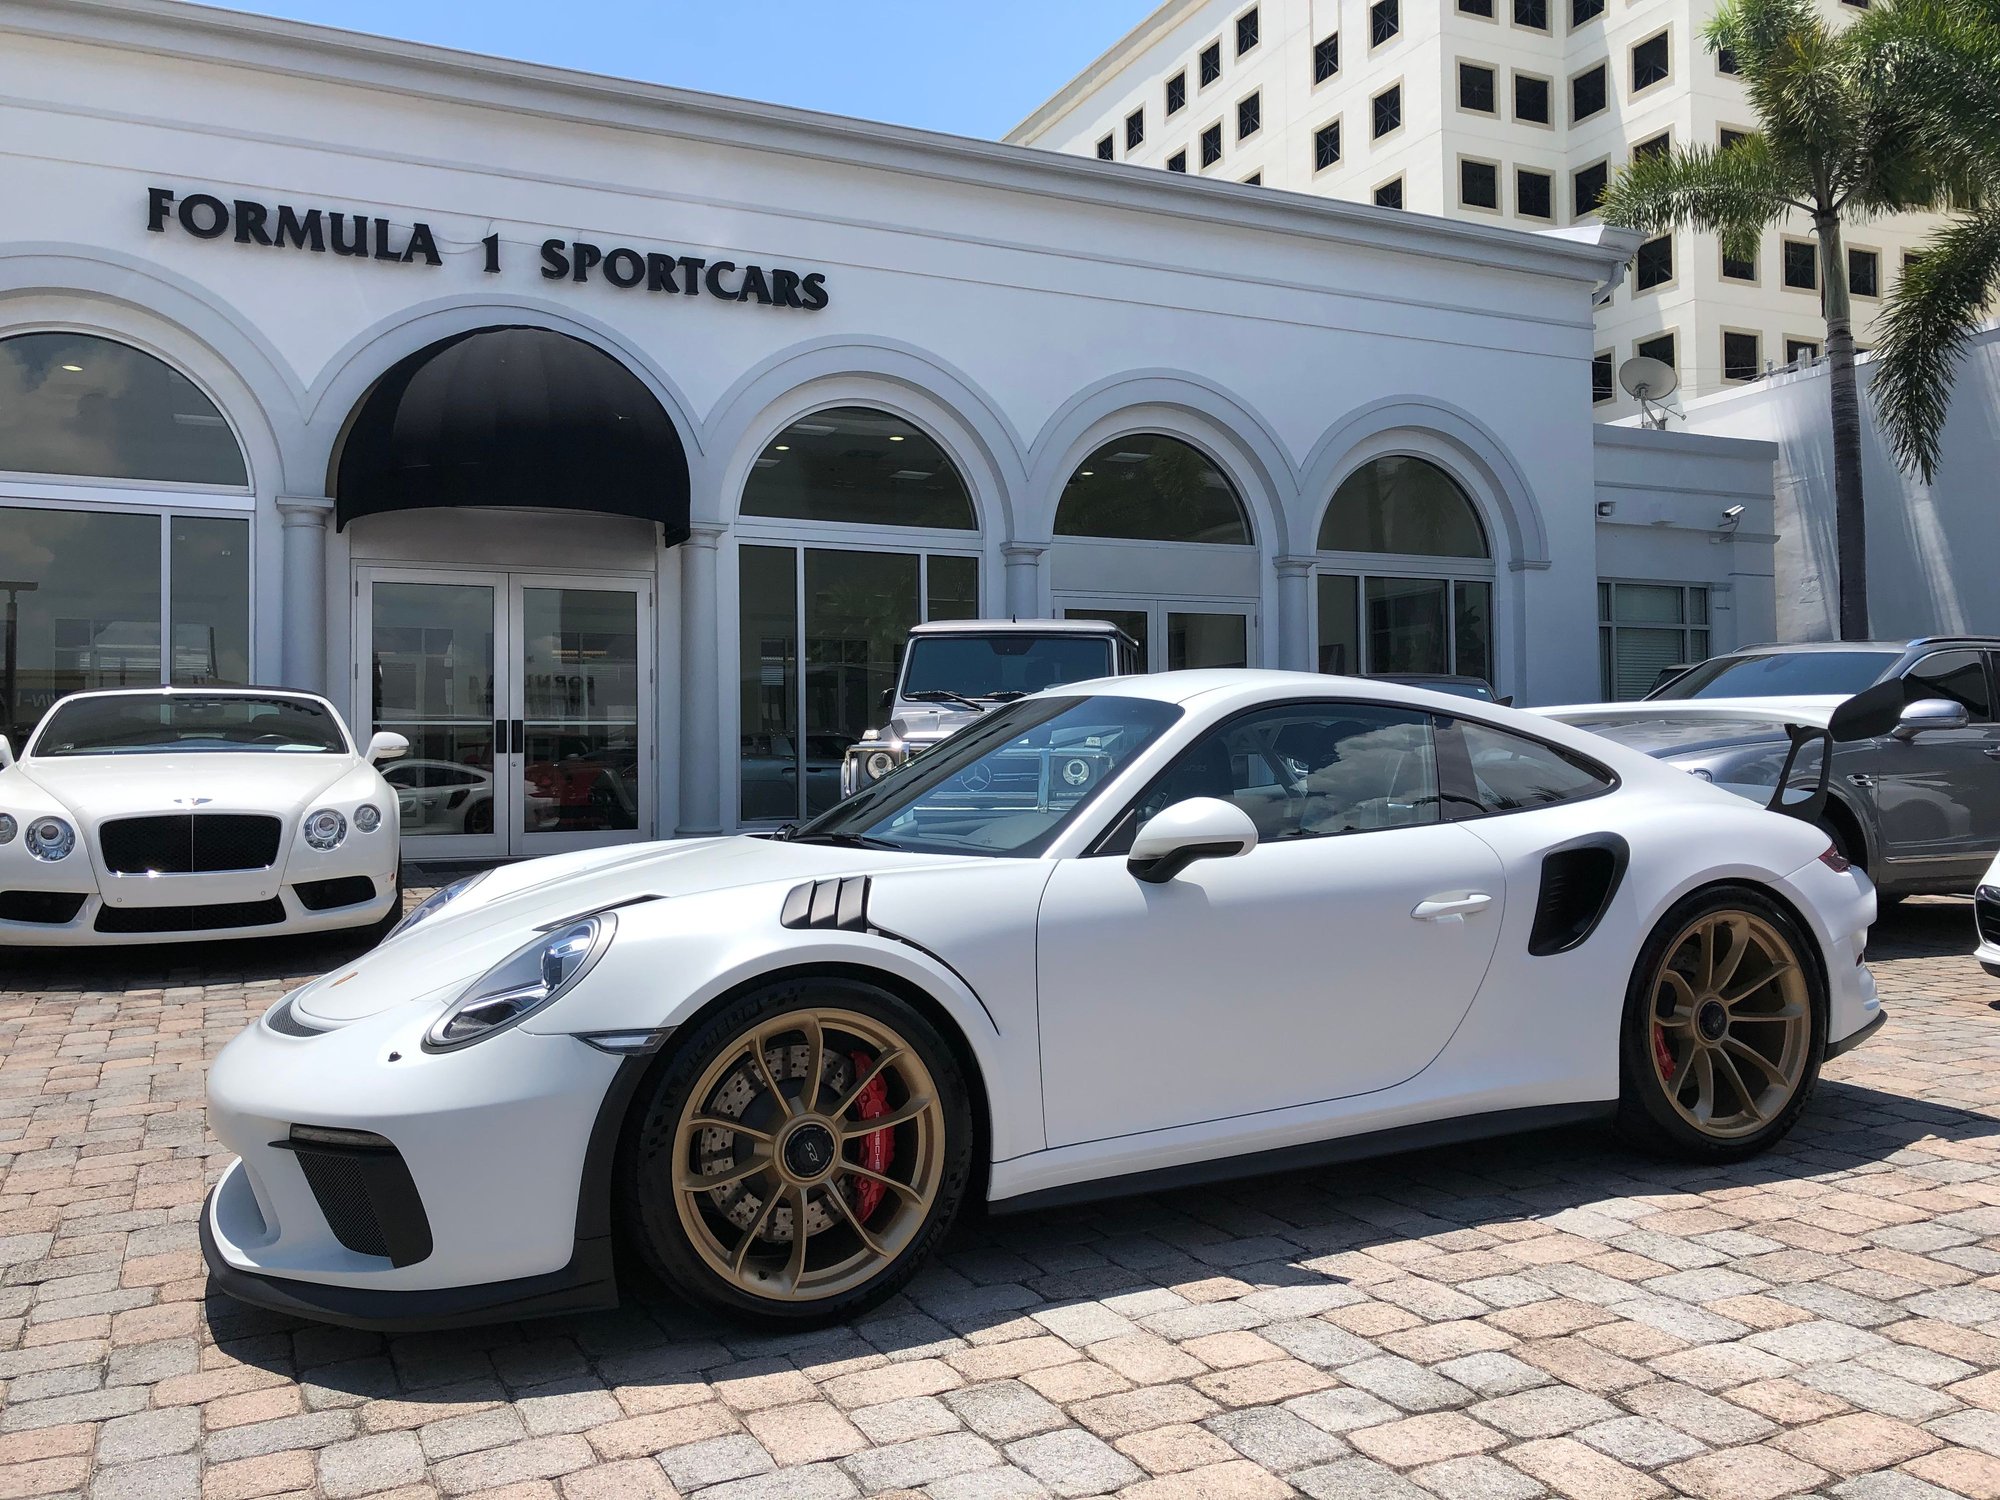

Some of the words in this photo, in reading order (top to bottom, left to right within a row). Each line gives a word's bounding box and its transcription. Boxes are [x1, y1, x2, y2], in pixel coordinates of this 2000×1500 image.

[147, 187, 443, 266] FORMULA
[481, 232, 501, 274] 1
[540, 238, 829, 311] SPORTCARS
